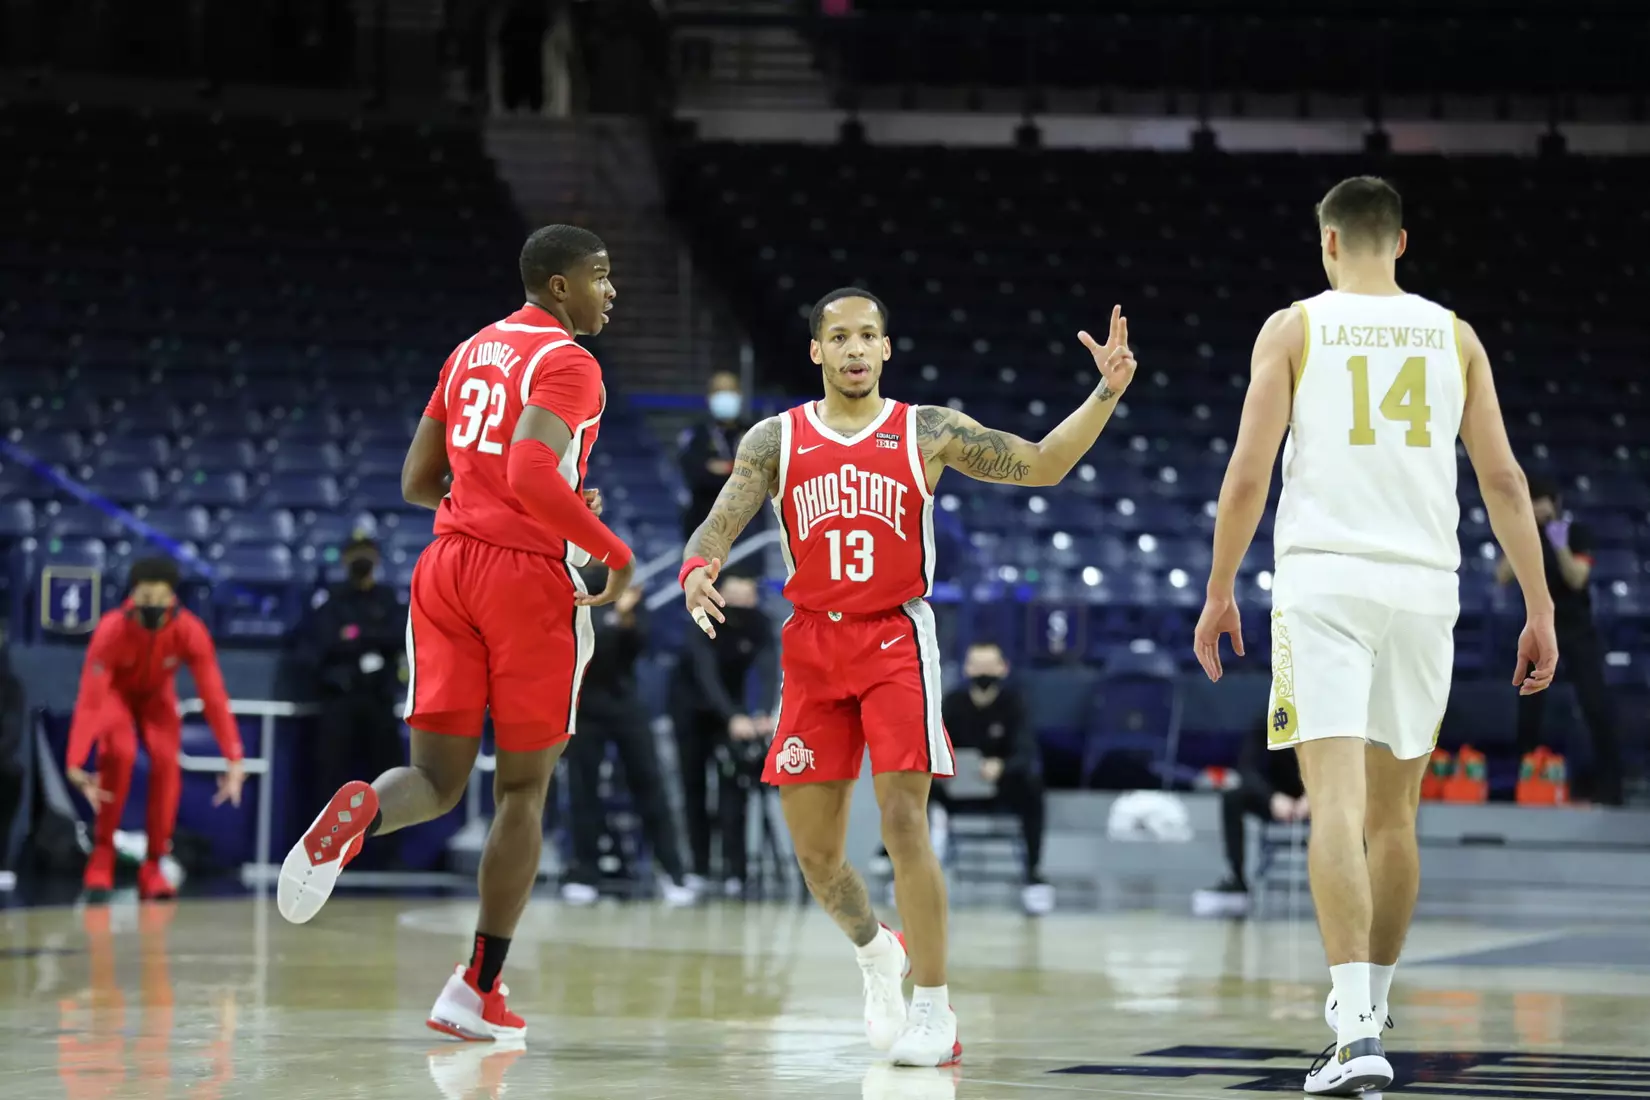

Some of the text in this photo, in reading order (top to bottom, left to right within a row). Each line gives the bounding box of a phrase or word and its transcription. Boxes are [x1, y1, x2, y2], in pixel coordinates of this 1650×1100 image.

[468, 341, 521, 378] LIDDELL
[1321, 325, 1446, 349] LASZEWSKI
[452, 377, 507, 455] 32
[1346, 355, 1431, 447] 14
[876, 432, 900, 441] EQUALITY
[824, 529, 874, 582] 13
